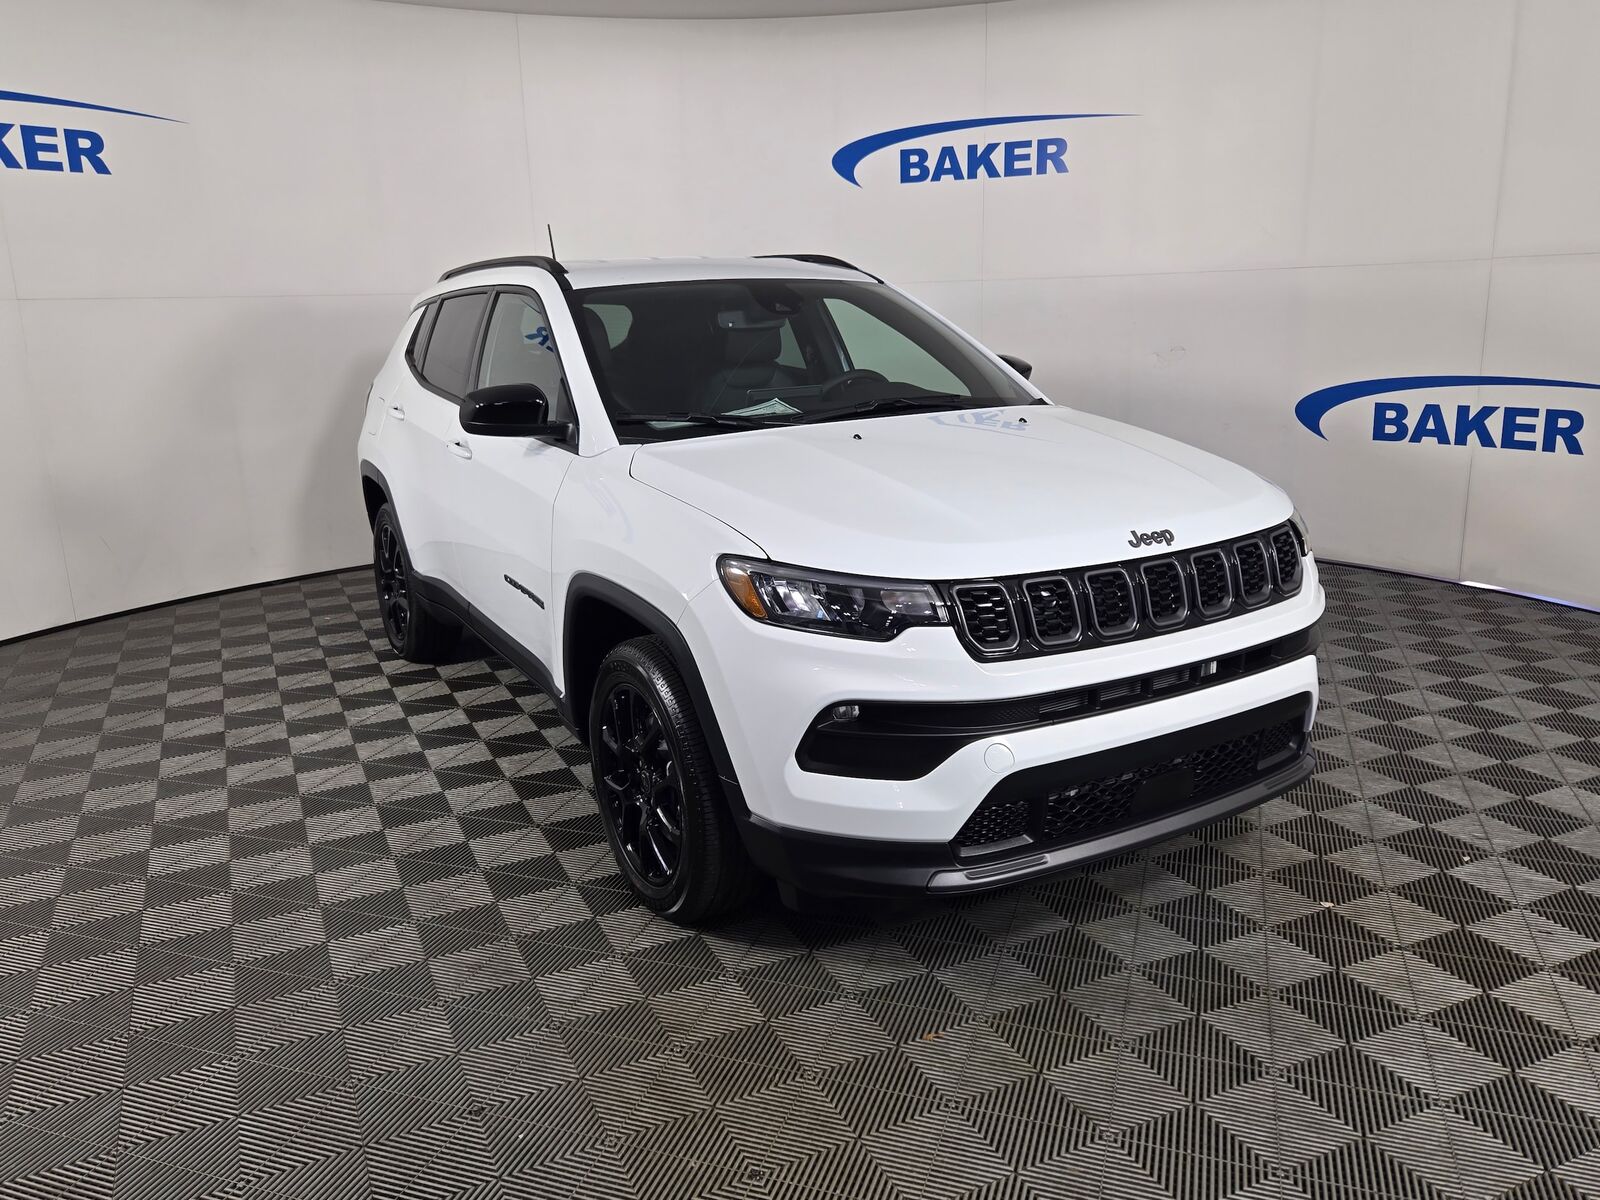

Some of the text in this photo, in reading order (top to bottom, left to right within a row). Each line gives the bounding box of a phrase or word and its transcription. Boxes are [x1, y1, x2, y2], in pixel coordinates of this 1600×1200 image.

[900, 137, 1069, 184] BAKER
[1372, 402, 1584, 455] BAKER
[1127, 529, 1175, 548] Jeep
